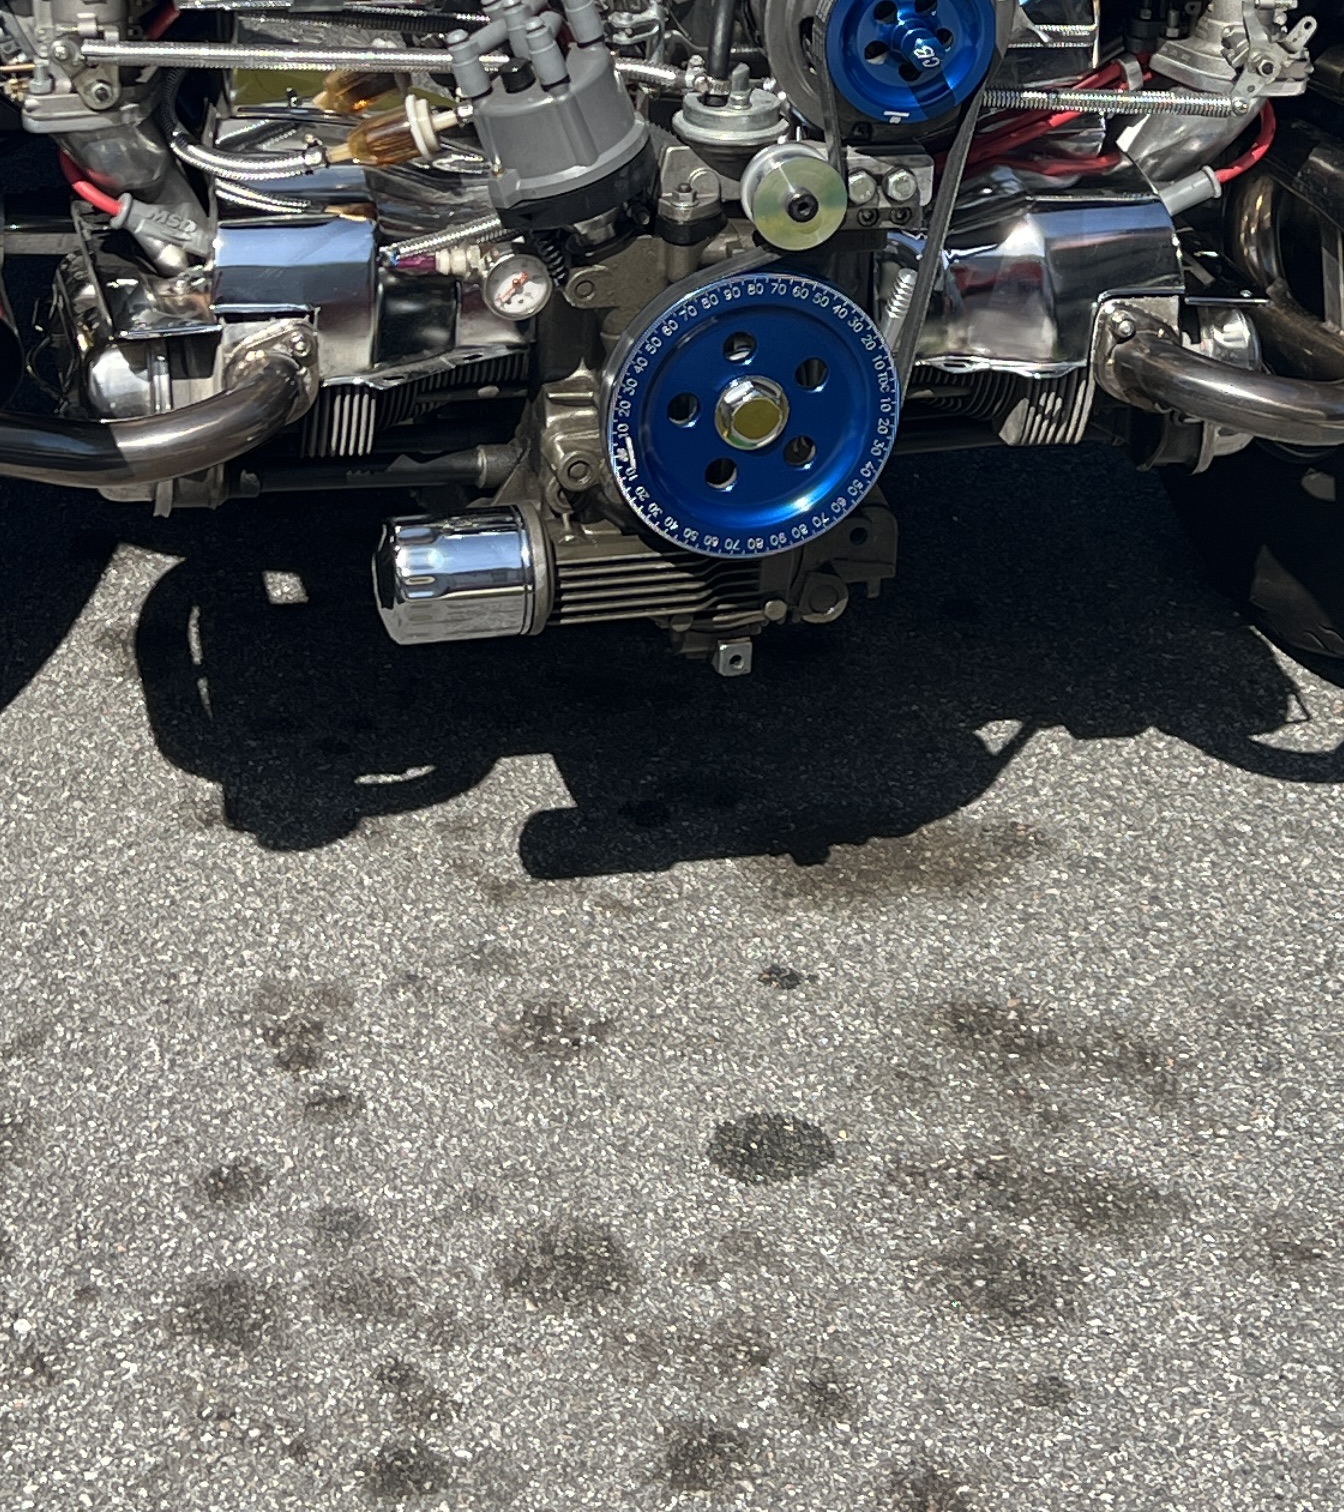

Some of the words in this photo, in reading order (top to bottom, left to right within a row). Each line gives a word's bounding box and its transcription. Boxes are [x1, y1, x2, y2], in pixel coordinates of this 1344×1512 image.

[913, 45, 941, 68] CB
[146, 207, 197, 233] MSD
[747, 282, 764, 296] 80
[771, 282, 787, 296] 70
[792, 285, 810, 299] 60
[701, 293, 719, 309] 80
[812, 291, 830, 308] 50
[678, 305, 697, 321] 70
[832, 304, 849, 320] 40
[661, 319, 679, 337] 60
[847, 316, 864, 333] 30
[645, 336, 662, 355] 50
[861, 334, 877, 351] 20
[634, 356, 648, 374] 40
[872, 354, 886, 370] 10
[623, 378, 638, 396] 30
[877, 372, 890, 393] TDC
[618, 400, 632, 418] 20
[880, 397, 892, 413] 10
[617, 423, 630, 439] 10
[877, 417, 890, 435] 20
[870, 439, 885, 456] 30
[625, 467, 638, 481] 10
[859, 461, 876, 478] 40
[635, 486, 650, 502] 20
[847, 479, 864, 496] 50
[648, 502, 663, 518] 30
[664, 516, 679, 530] 40
[812, 512, 829, 528] 70
[683, 527, 699, 542] 50
[791, 523, 808, 540] 80
[724, 537, 740, 551] 70
